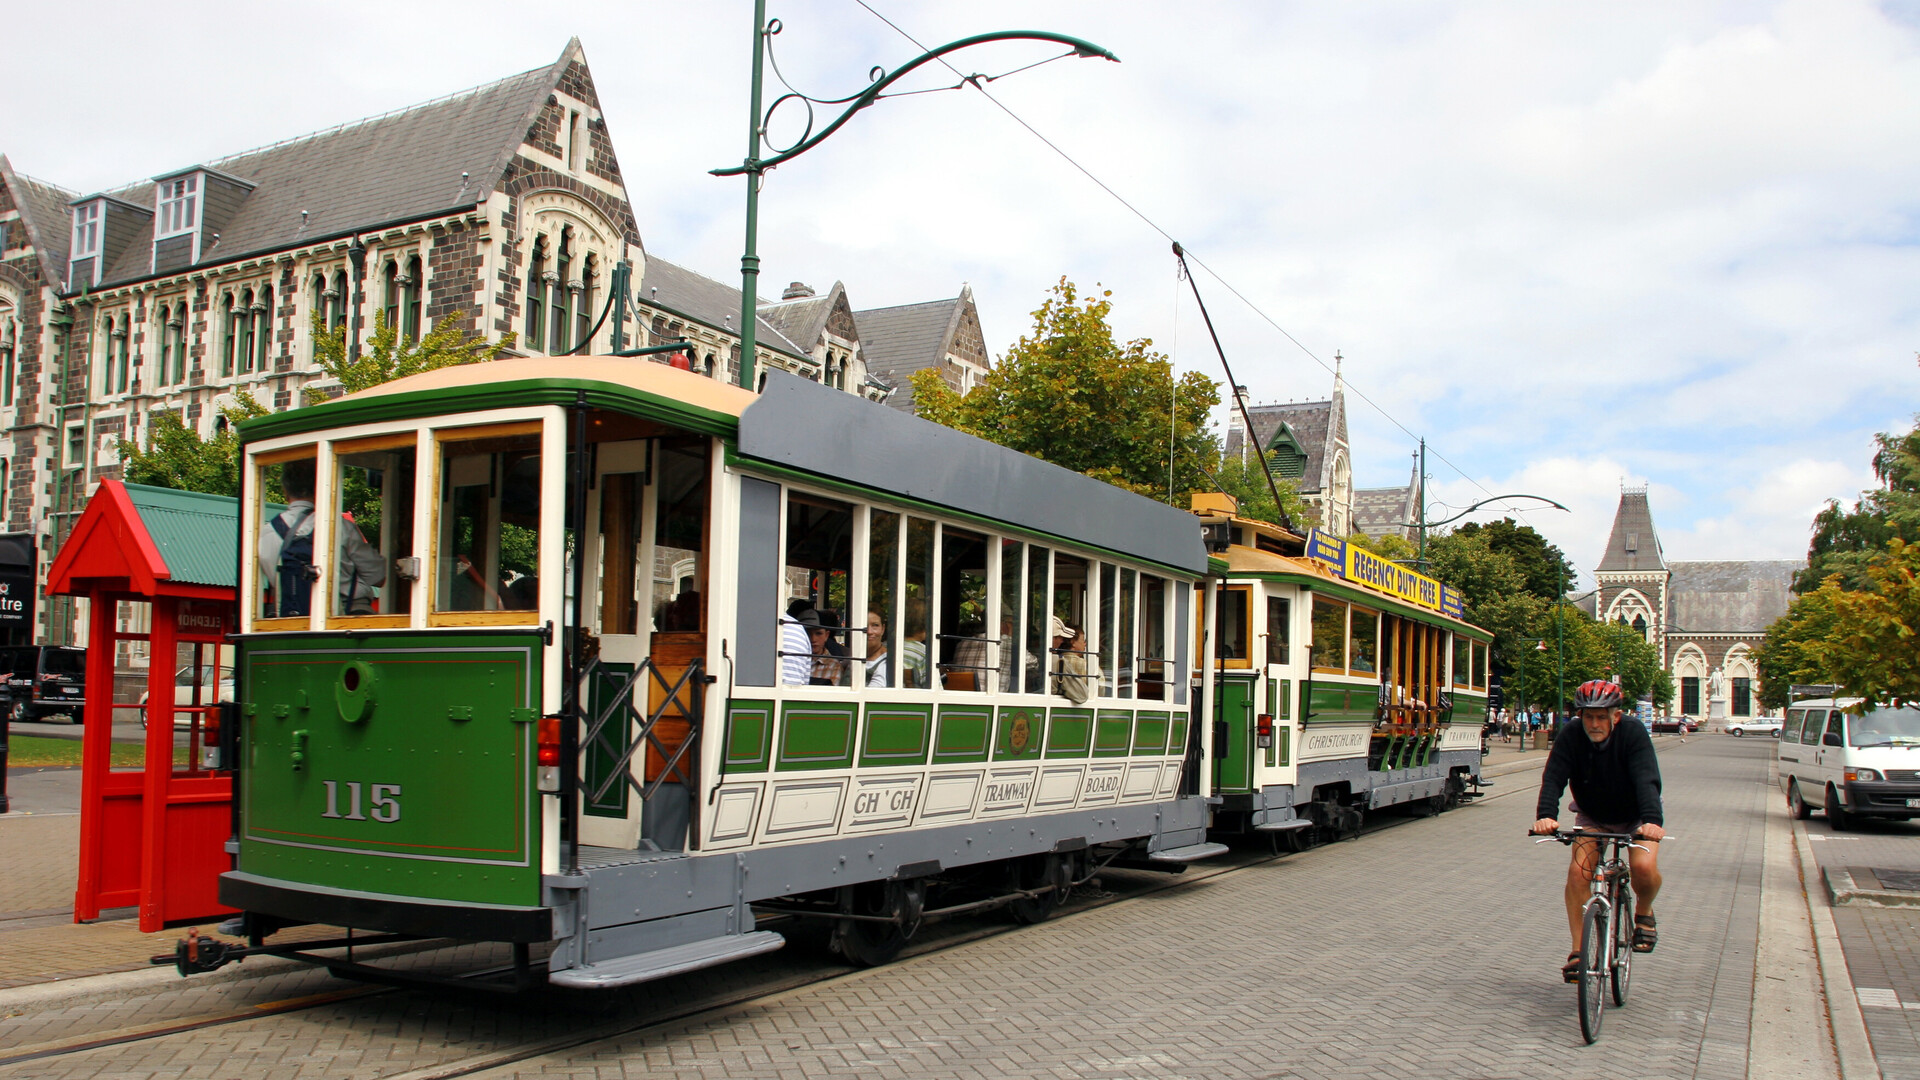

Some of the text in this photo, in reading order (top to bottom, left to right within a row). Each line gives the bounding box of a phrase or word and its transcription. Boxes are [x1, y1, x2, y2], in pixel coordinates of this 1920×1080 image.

[1354, 550, 1395, 590] REGENCY
[1397, 569, 1417, 598] DUTY
[1419, 578, 1436, 605] FREE
[0, 597, 23, 611] tre
[321, 780, 402, 823] 115
[985, 781, 1033, 802] TRAMWAY
